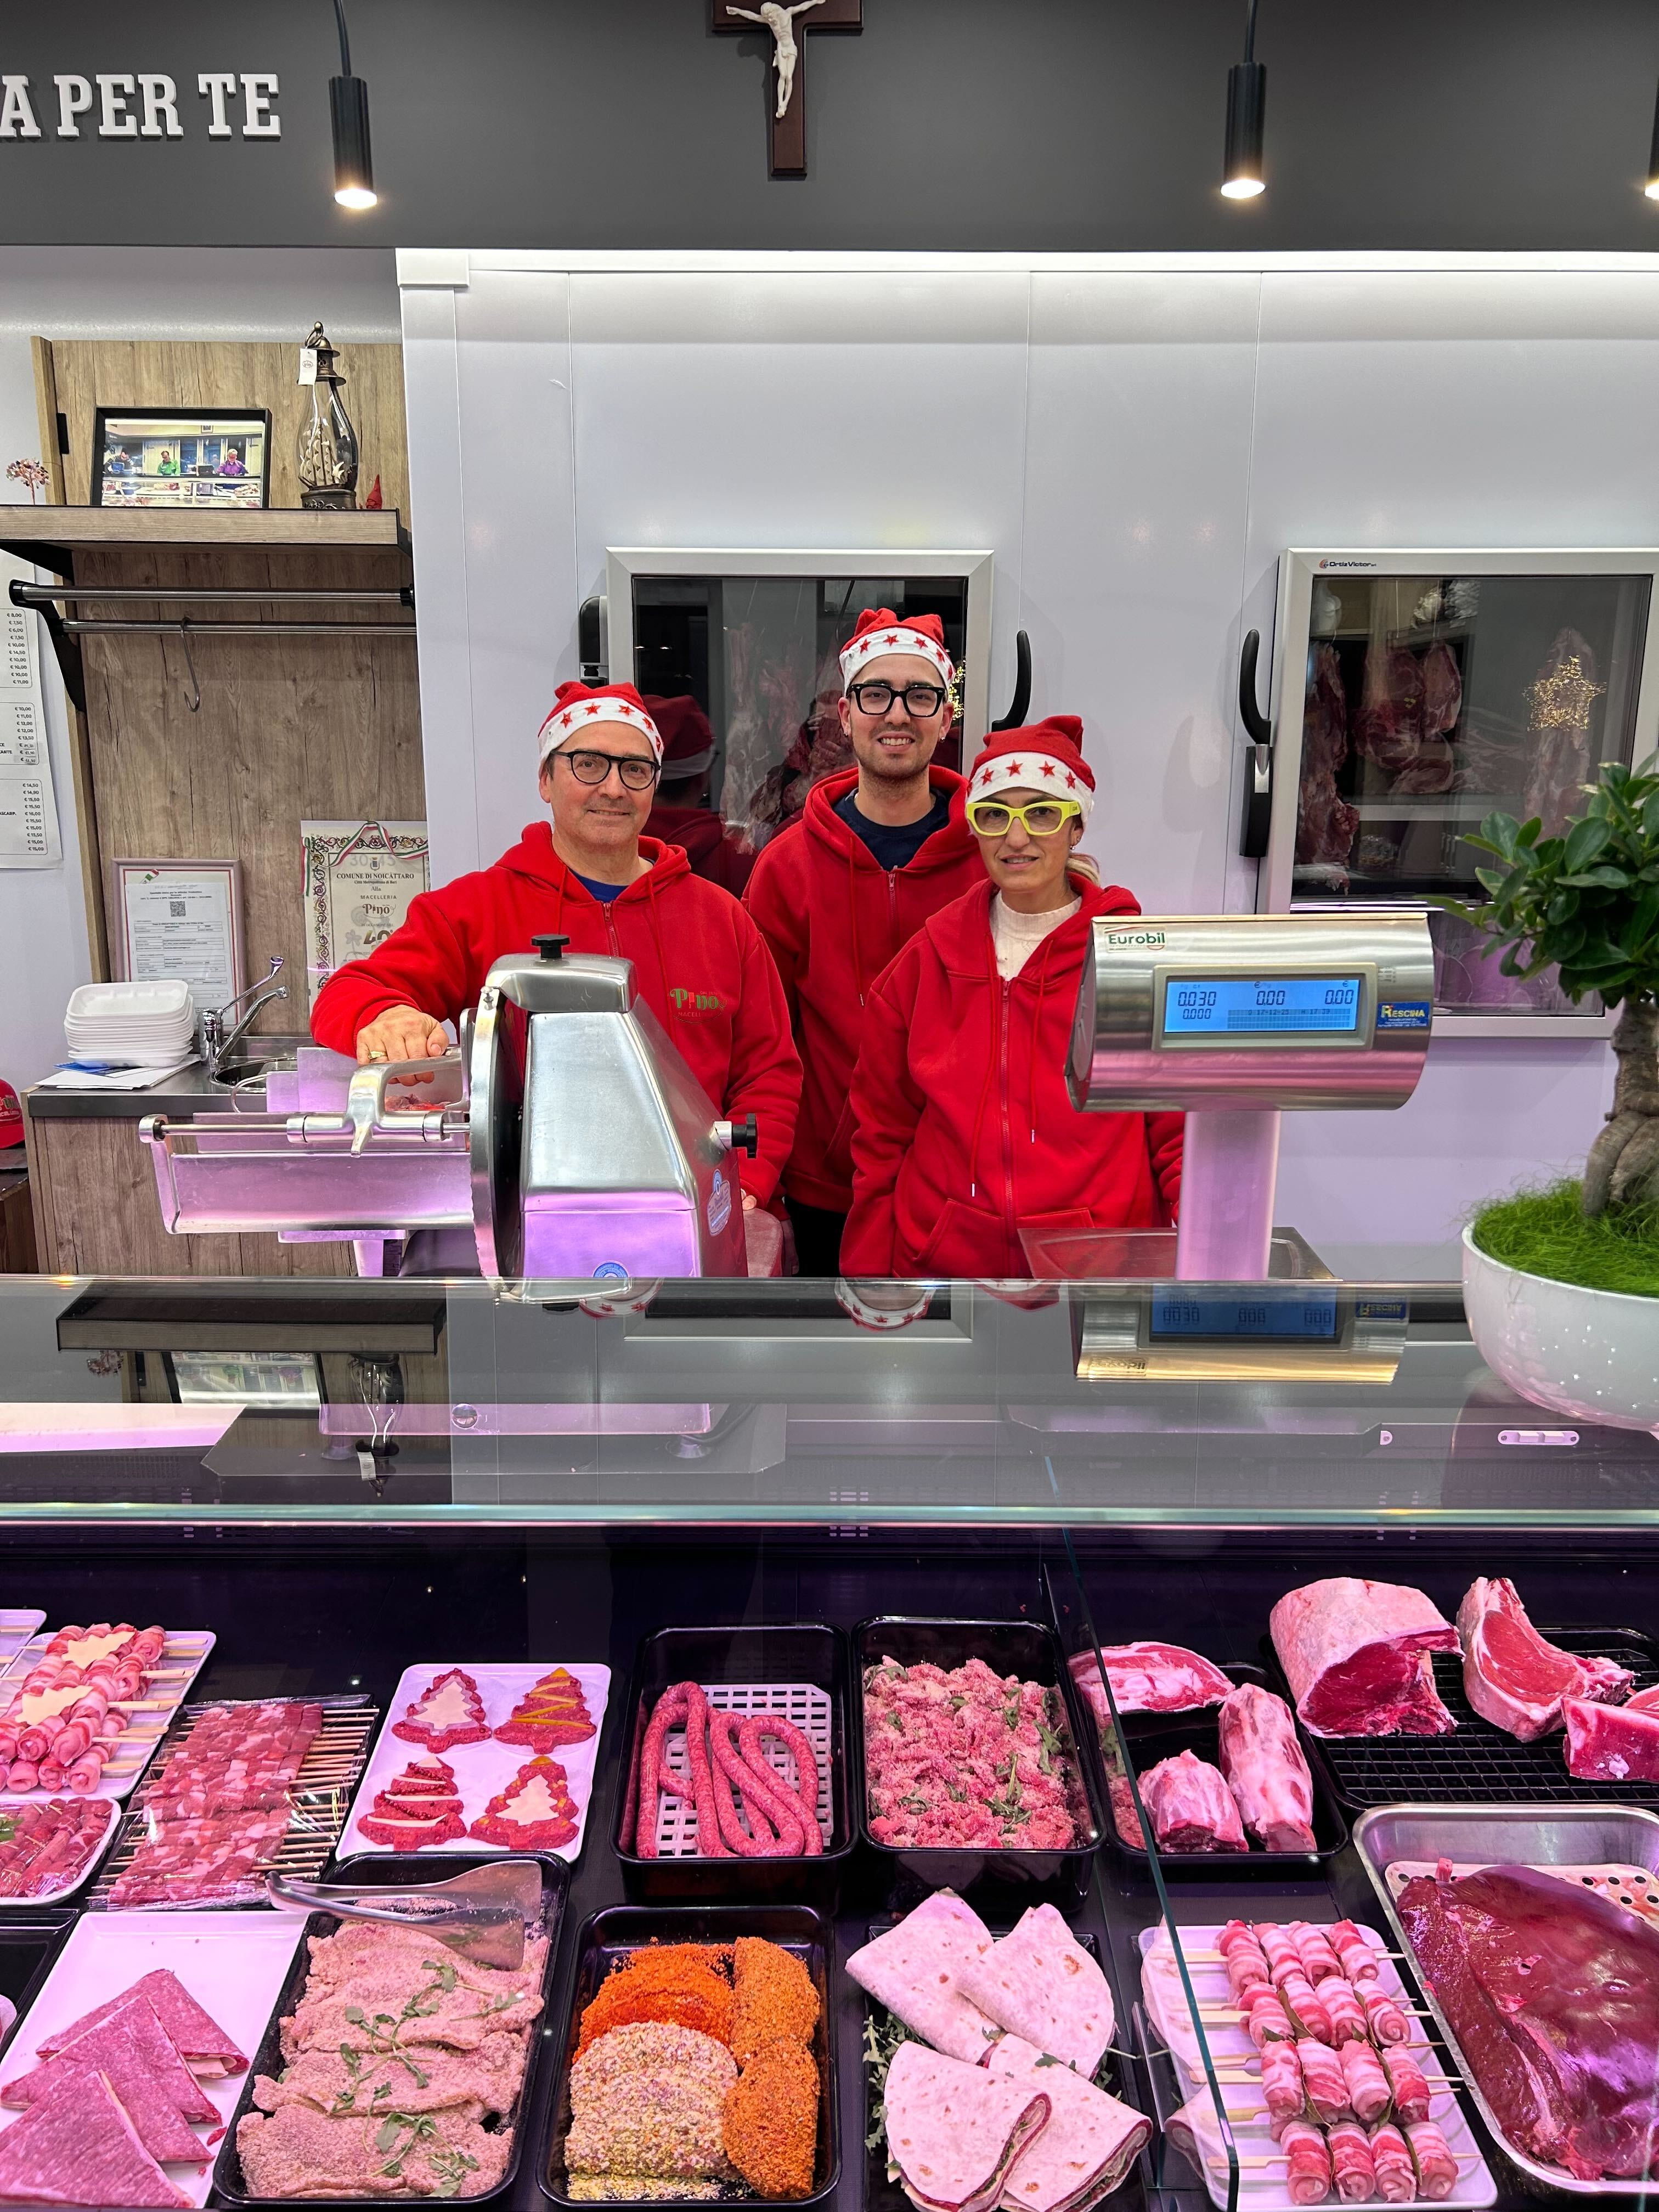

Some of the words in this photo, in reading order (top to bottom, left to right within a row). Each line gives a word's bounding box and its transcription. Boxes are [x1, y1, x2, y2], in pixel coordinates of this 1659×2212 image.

[0, 75, 42, 138] A
[53, 74, 184, 138] PER
[198, 73, 282, 137] TE
[362, 903, 390, 915] Pino
[1108, 932, 1165, 944] Eurobil
[1381, 1005, 1425, 1018] RESCINA
